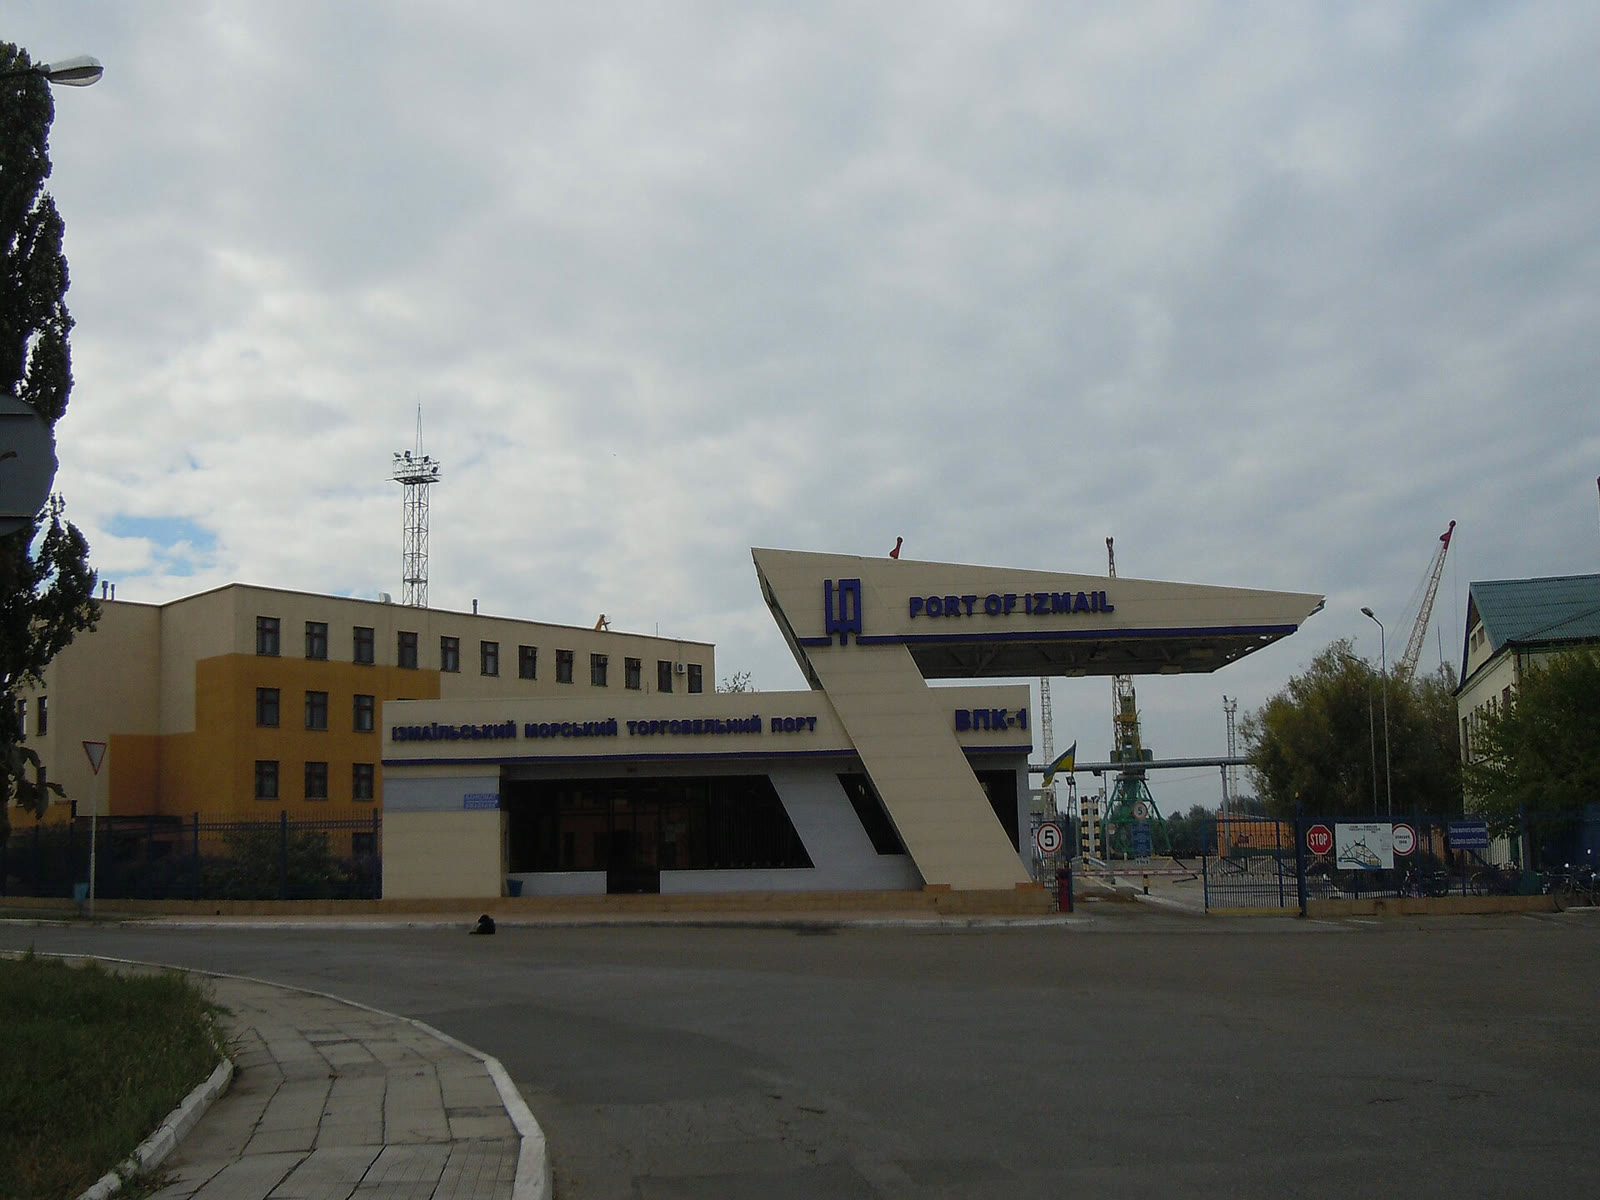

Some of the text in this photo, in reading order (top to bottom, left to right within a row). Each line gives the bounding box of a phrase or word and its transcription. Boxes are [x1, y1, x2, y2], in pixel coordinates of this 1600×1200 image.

[910, 591, 1115, 618] PORT OF IZMAIL
[391, 714, 817, 741] ІЗМАЇЛЬСЬКИЙ МОРСЬКИЙ ТОРГОВЕЛЬНИЙ ПОРТ
[955, 708, 1027, 731] ВПК-1
[1044, 830, 1055, 847] 5
[1309, 833, 1328, 846] STOP
